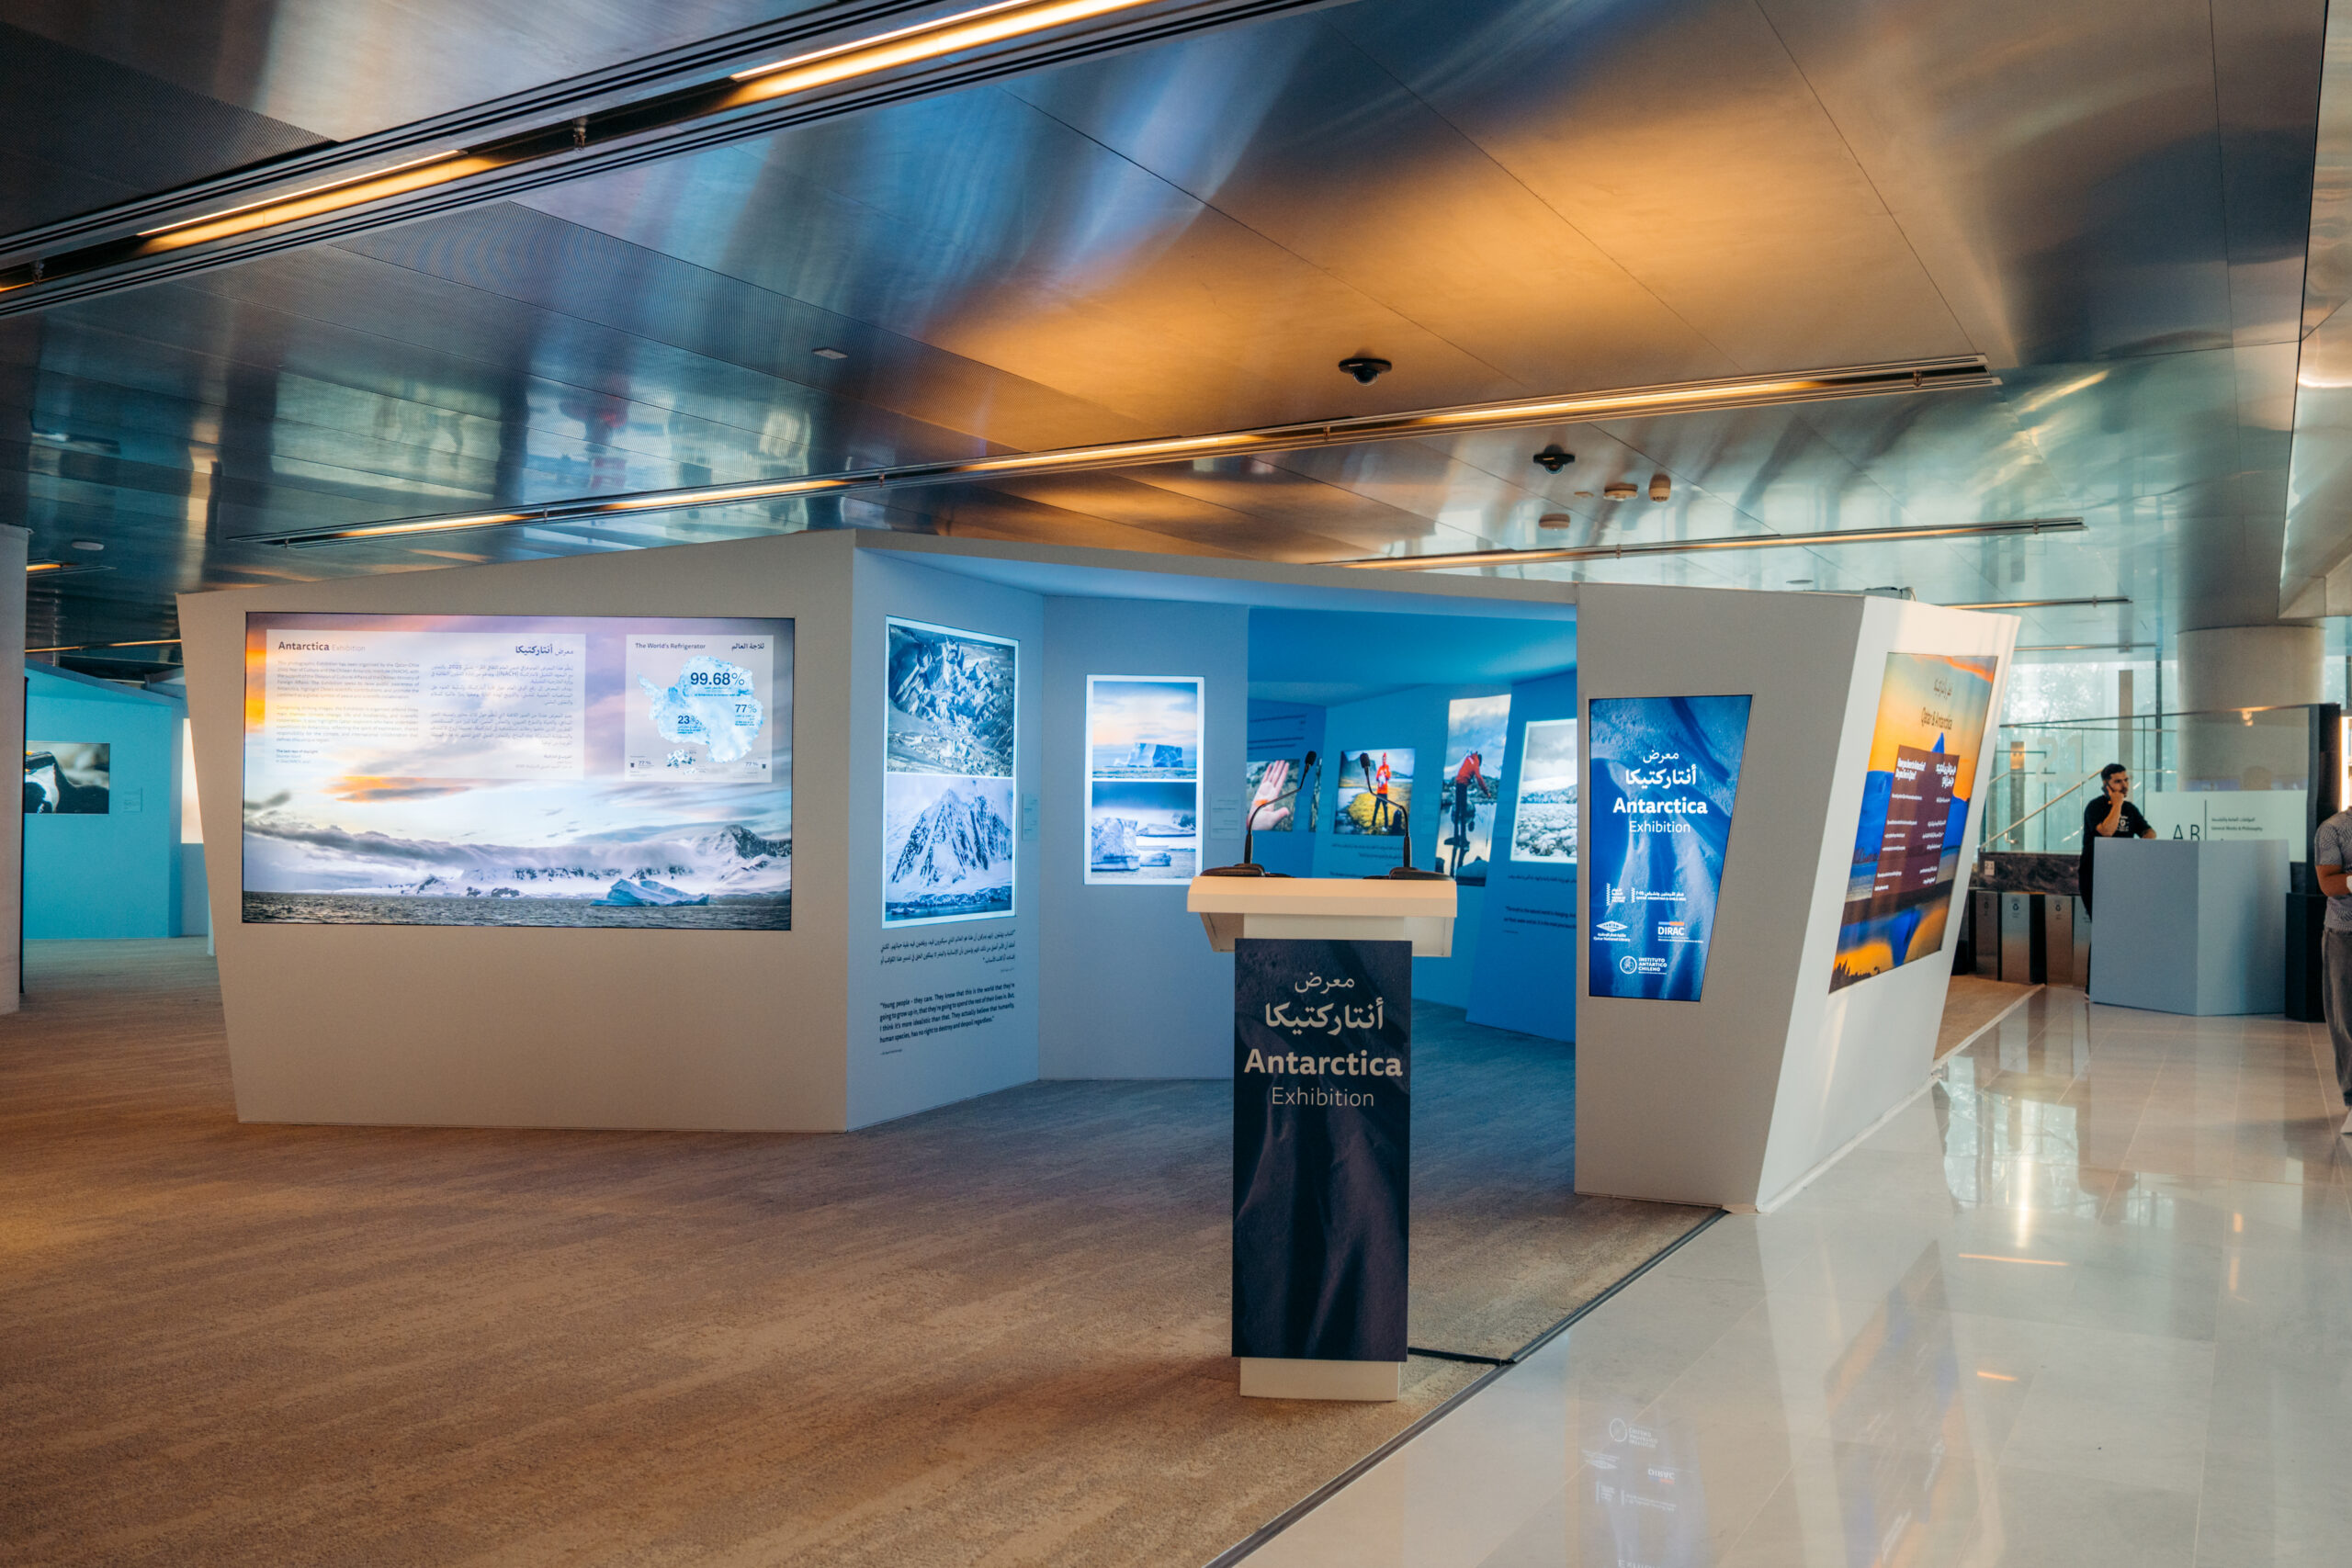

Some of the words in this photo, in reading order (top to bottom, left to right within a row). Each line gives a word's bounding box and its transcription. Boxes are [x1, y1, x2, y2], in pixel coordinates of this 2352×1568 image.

[278, 641, 330, 650] Antarctica
[332, 644, 366, 652] Exhibition
[515, 644, 553, 656] أنتاركتيكا
[731, 643, 748, 651] العالم
[690, 671, 744, 685] 99.68%
[735, 704, 757, 714] 77%
[677, 716, 699, 725] 23%
[1643, 750, 1679, 763] معرض
[1625, 764, 1697, 789] أنتاركتيكا
[1613, 796, 1708, 814] Antarctica
[1629, 821, 1690, 832] Exhibition
[2173, 824, 2183, 840] A
[1657, 927, 1685, 935] DIRAC
[1295, 972, 1355, 994] معرض
[896, 999, 910, 1008] people
[879, 1014, 891, 1022] going
[942, 1003, 952, 1011] going
[961, 1009, 976, 1017] actually
[1265, 997, 1384, 1035] أنتاركتيكا
[1244, 1049, 1403, 1077] Antarctica
[1272, 1087, 1374, 1107] Exhibition
